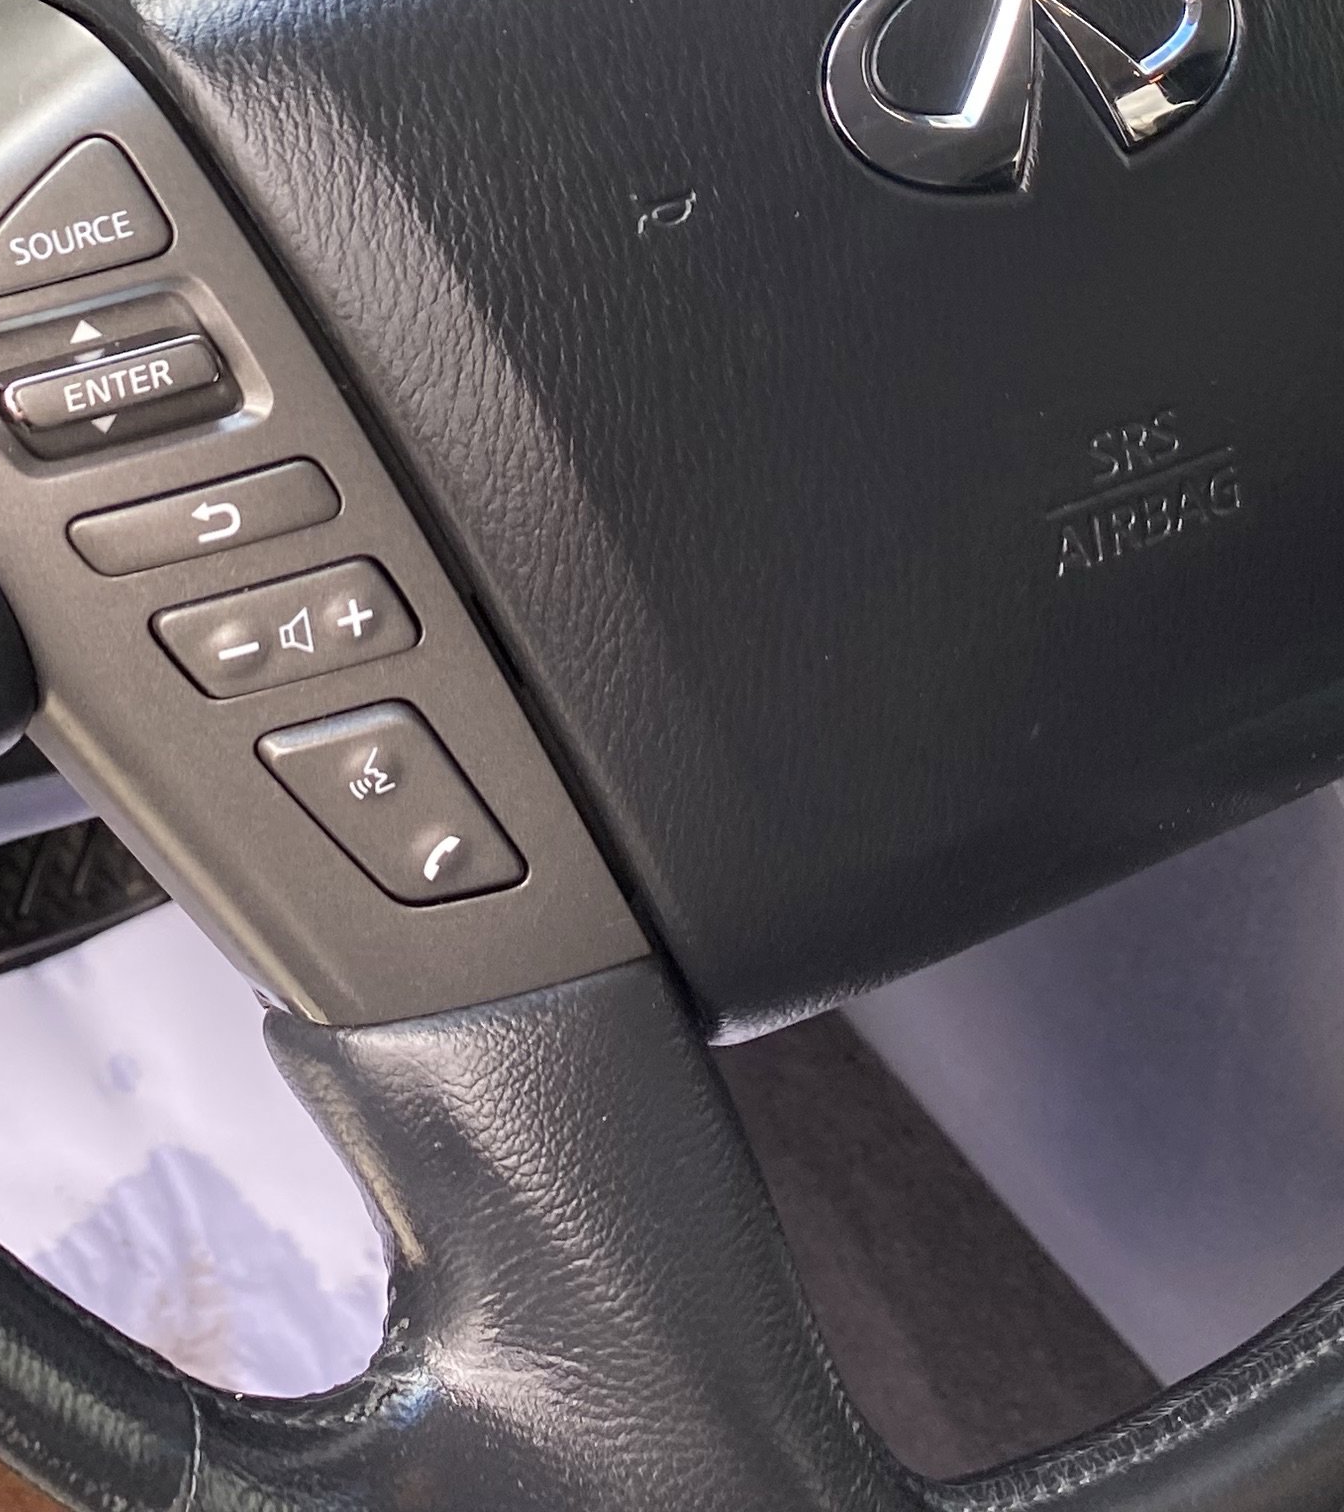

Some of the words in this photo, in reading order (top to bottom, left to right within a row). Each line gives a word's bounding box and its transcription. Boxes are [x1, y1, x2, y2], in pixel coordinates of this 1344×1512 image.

[9, 210, 134, 266] SOURCE
[63, 359, 174, 413] ENTER
[1089, 406, 1181, 484] SRS
[1056, 466, 1241, 579] AIRBAG
